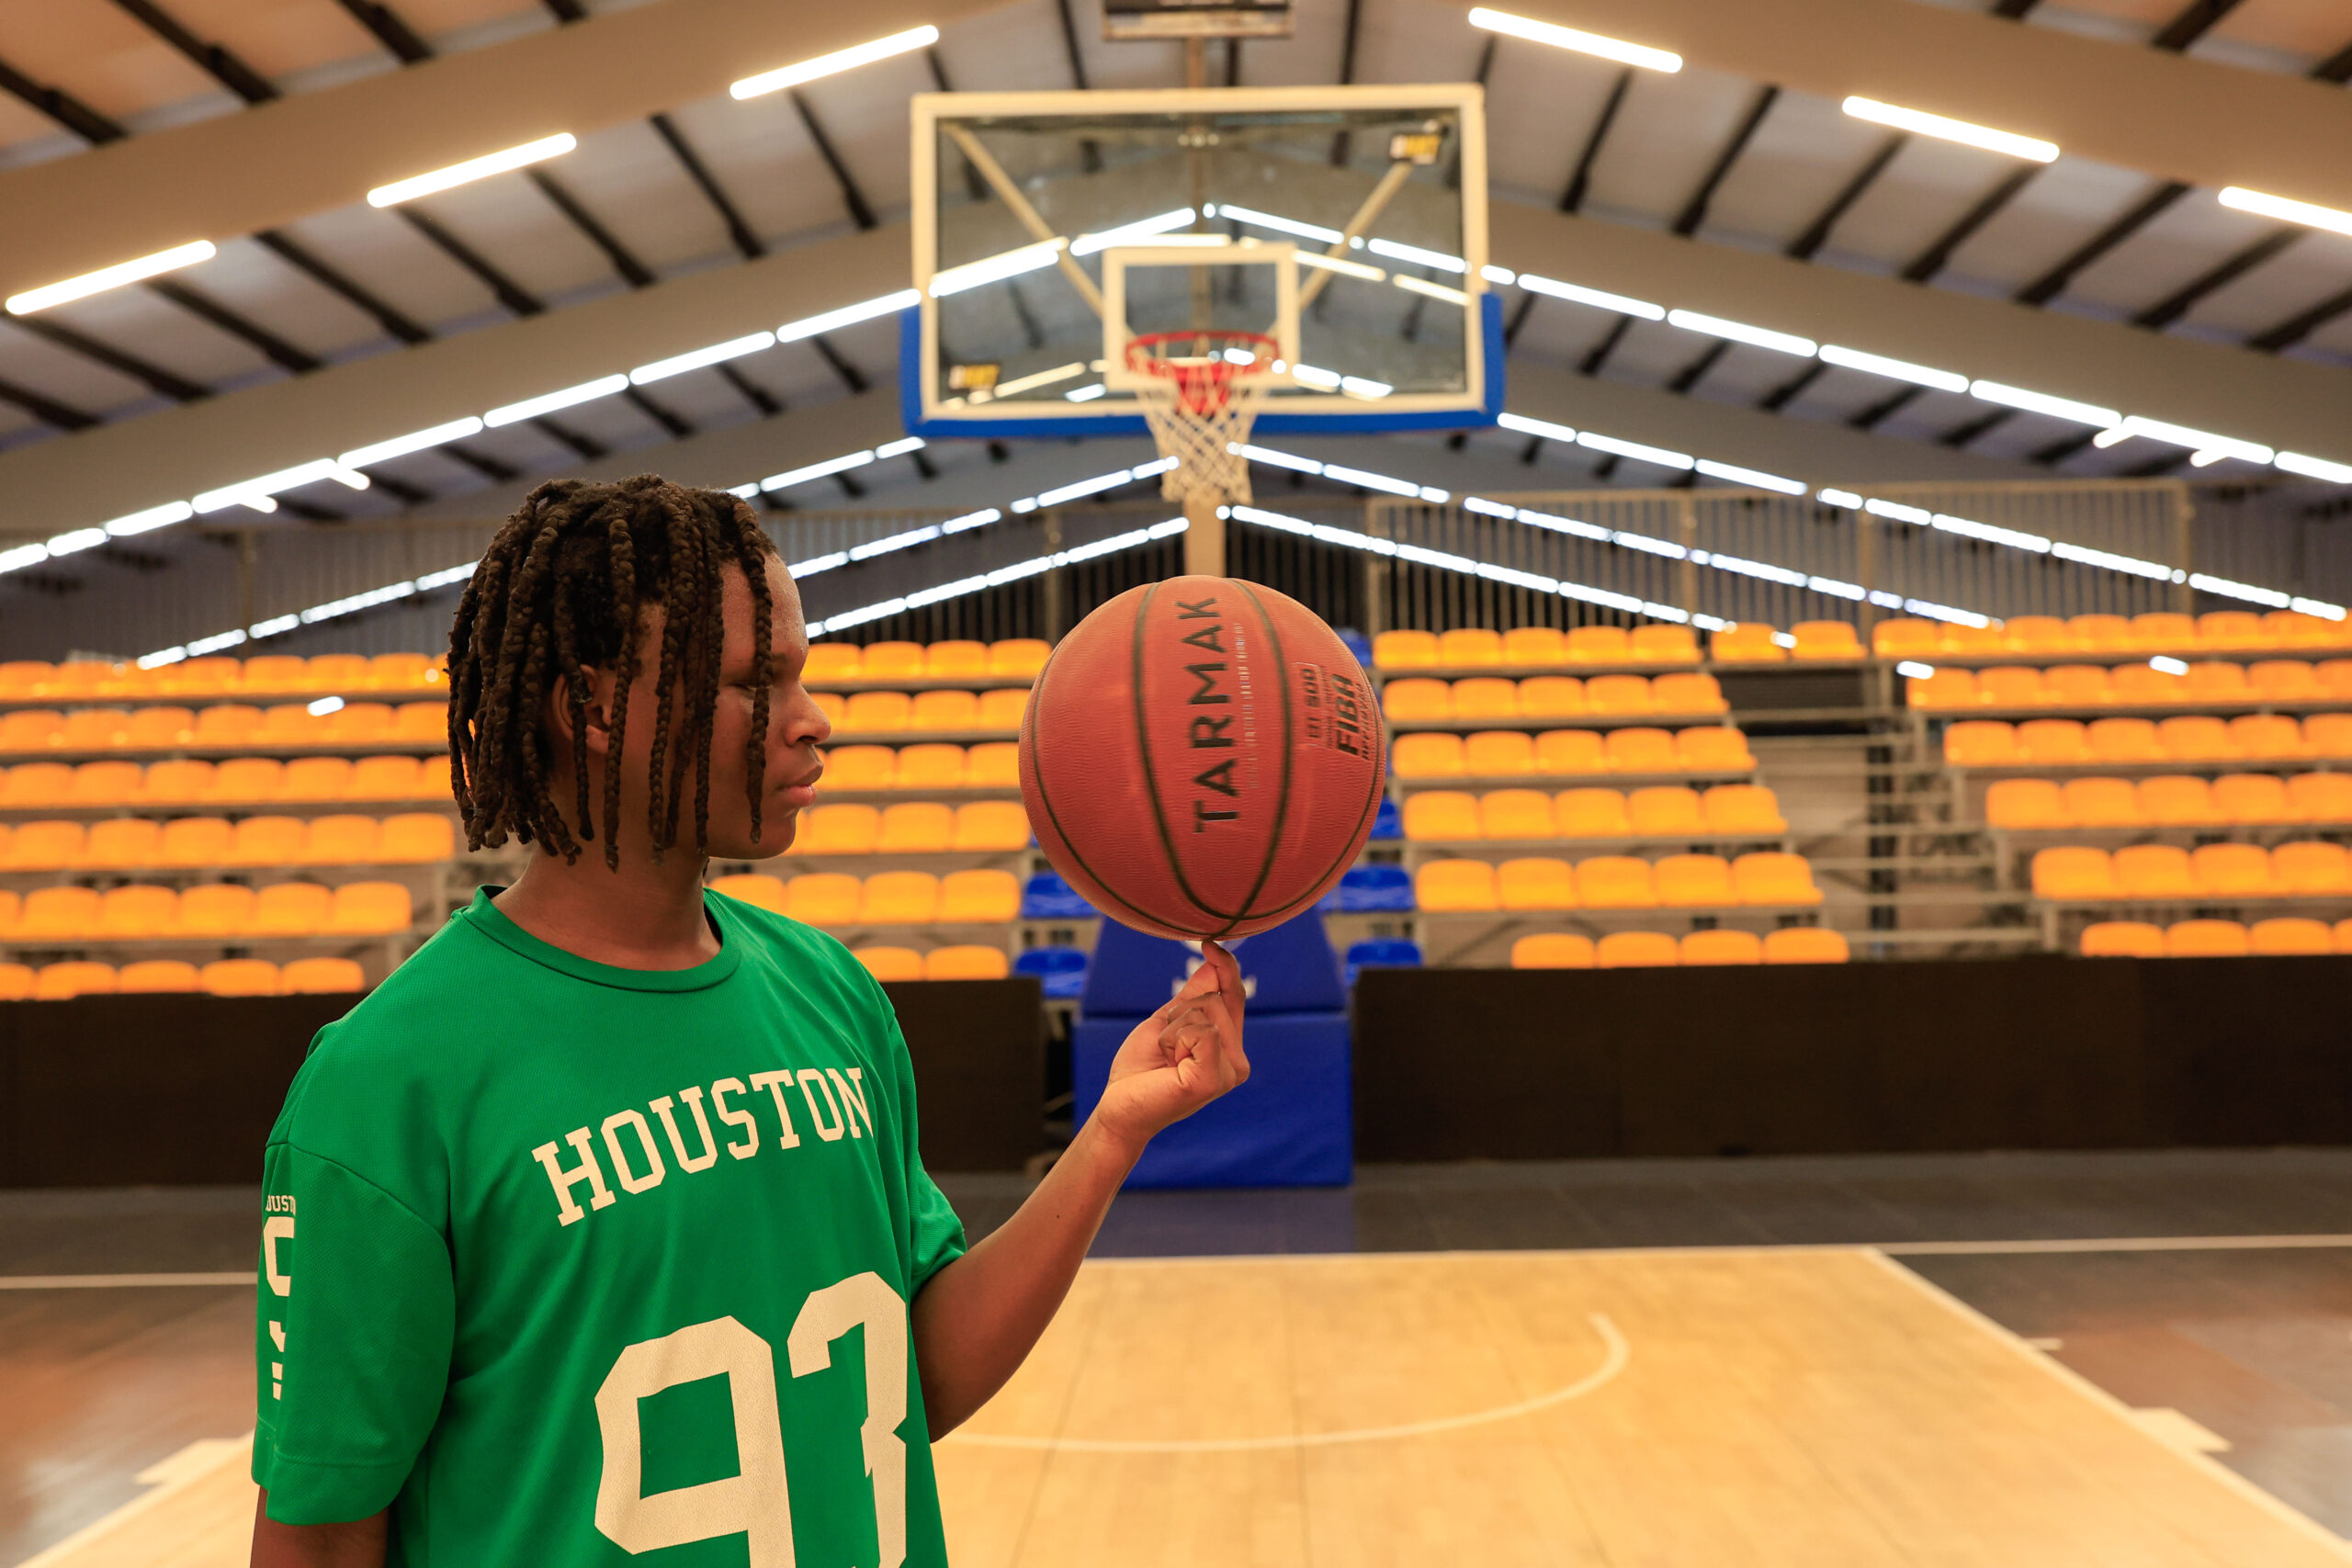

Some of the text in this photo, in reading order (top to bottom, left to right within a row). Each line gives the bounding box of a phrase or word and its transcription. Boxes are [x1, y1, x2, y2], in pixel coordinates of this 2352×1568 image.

[1175, 597, 1239, 834] TARMAK
[1330, 673, 1360, 756] FIBA
[531, 1067, 874, 1227] HOUSTON
[594, 1270, 909, 1568] 93
